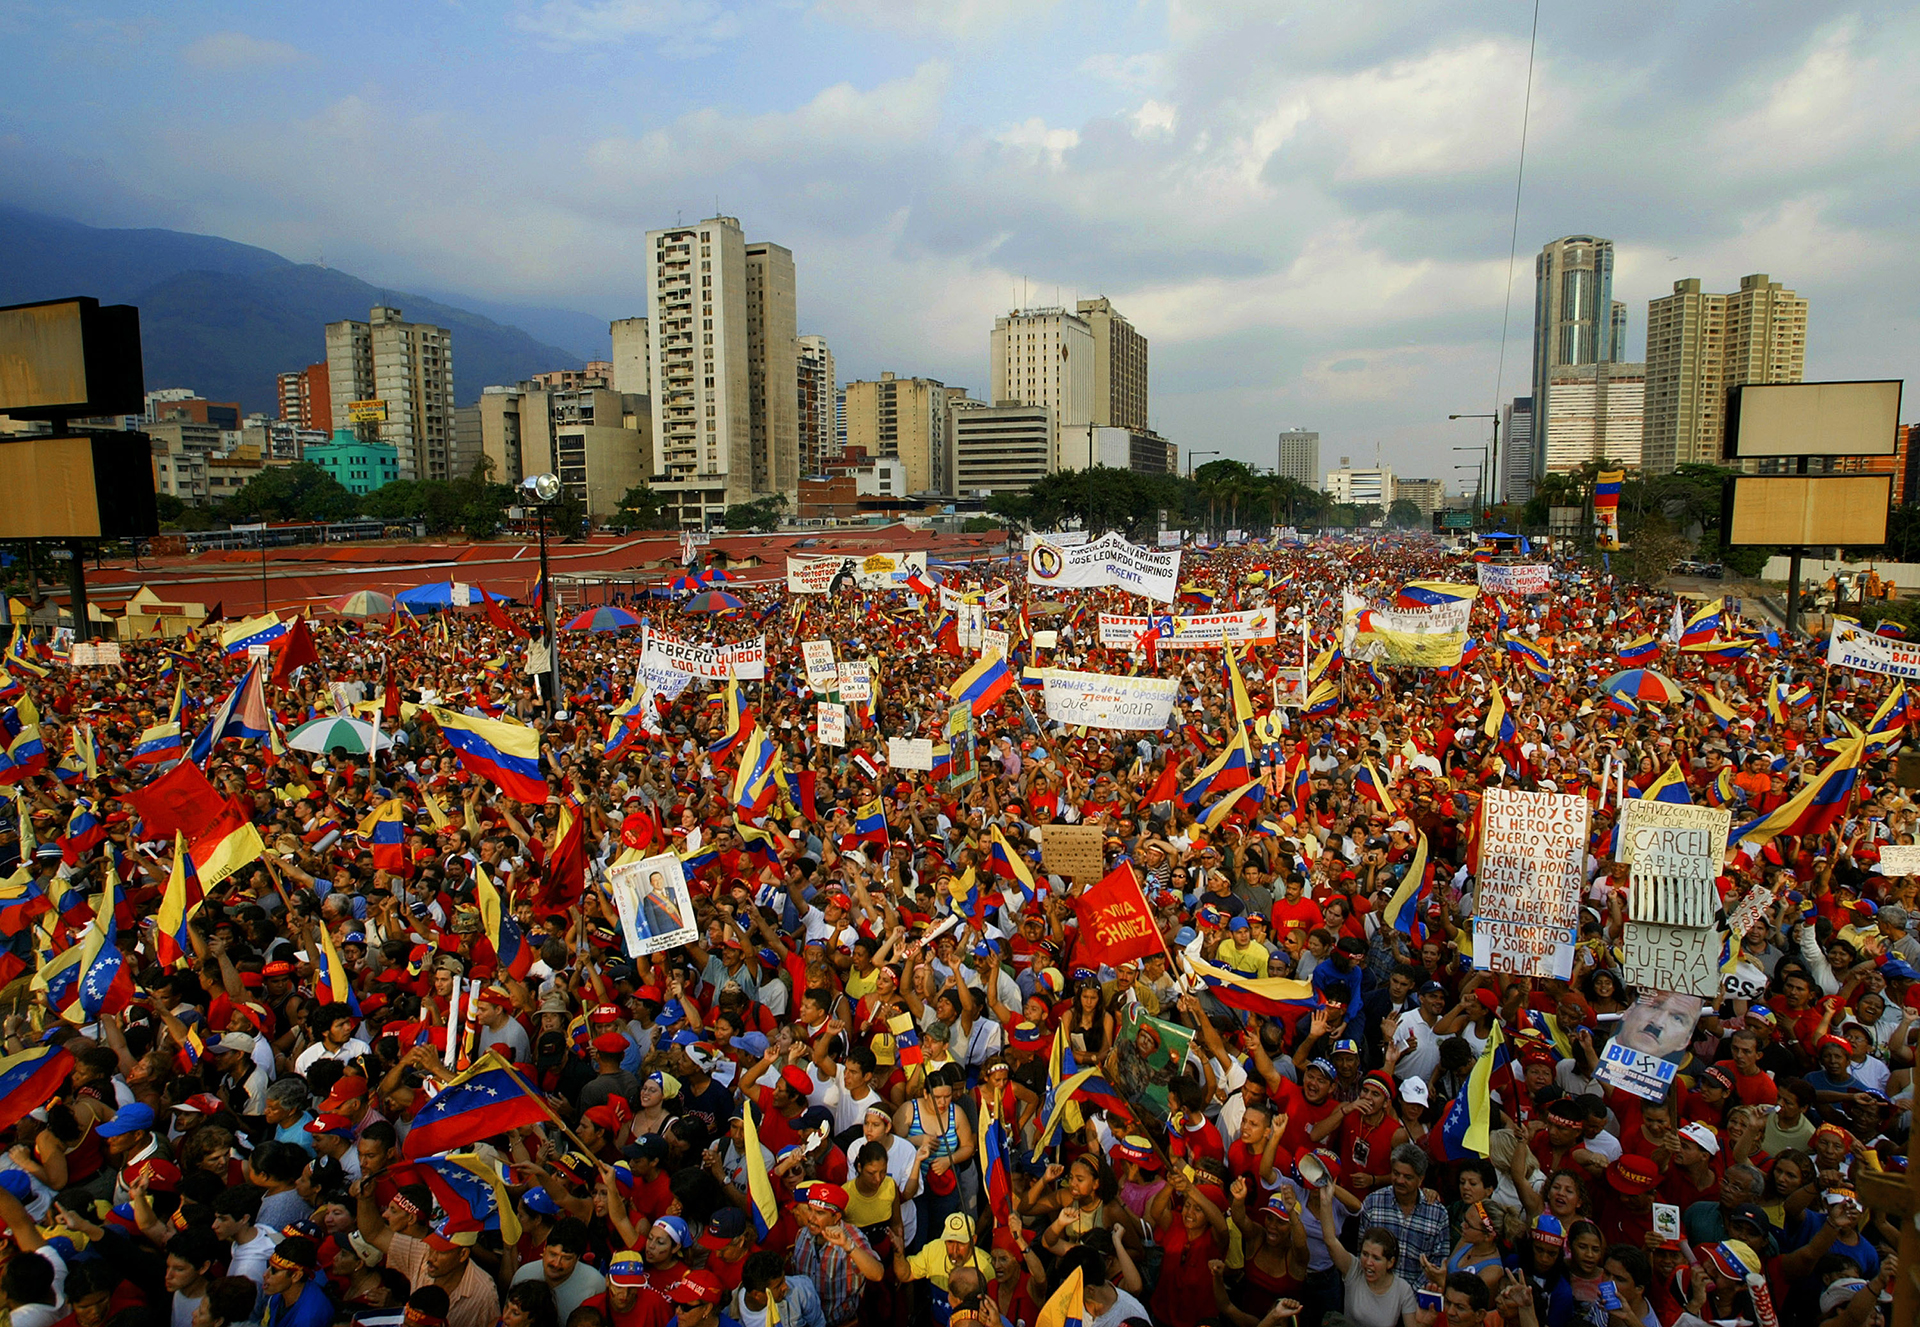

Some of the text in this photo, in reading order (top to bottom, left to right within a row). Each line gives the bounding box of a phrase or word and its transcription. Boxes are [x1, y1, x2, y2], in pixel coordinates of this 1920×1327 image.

[1113, 536, 1172, 566] BOLIVARIANOS
[1069, 554, 1091, 565] JOSE
[1135, 562, 1173, 578] CHIRINOS
[1429, 609, 1464, 620] VUELTA
[1439, 603, 1452, 612] DE
[1435, 617, 1466, 628] CAMPO
[648, 640, 712, 664] FEBRERO
[1892, 652, 1920, 665] BAJ
[1842, 655, 1917, 676] APOYANDO
[1563, 796, 1585, 807] DE
[1489, 803, 1583, 822] DIOS HOY ES
[1629, 800, 1730, 824] CHAVEZ CON TANTO
[1488, 816, 1503, 829] EL
[1628, 813, 1727, 836] AMOR QUE SIENTES
[1488, 830, 1539, 845] PUEBLO
[1633, 830, 1708, 857] CARCEL
[1545, 848, 1574, 860] QUE
[1633, 853, 1700, 869] CARLOS
[1521, 858, 1536, 872] LA
[1540, 861, 1581, 876] HONDA
[1633, 863, 1700, 879] ORTEGA
[1483, 867, 1580, 890] DE LA FE EN LAS
[1482, 881, 1523, 897] MANOS
[1528, 887, 1536, 899] Y
[1538, 889, 1550, 901] LA
[1480, 908, 1577, 929] PARA DARLE MUE
[1476, 921, 1497, 935] RTE
[1500, 923, 1513, 937] AL
[1626, 924, 1707, 952] BUSH
[1492, 936, 1501, 949] Y
[1625, 944, 1709, 975] FUERA
[1625, 967, 1709, 997] DE IRAK
